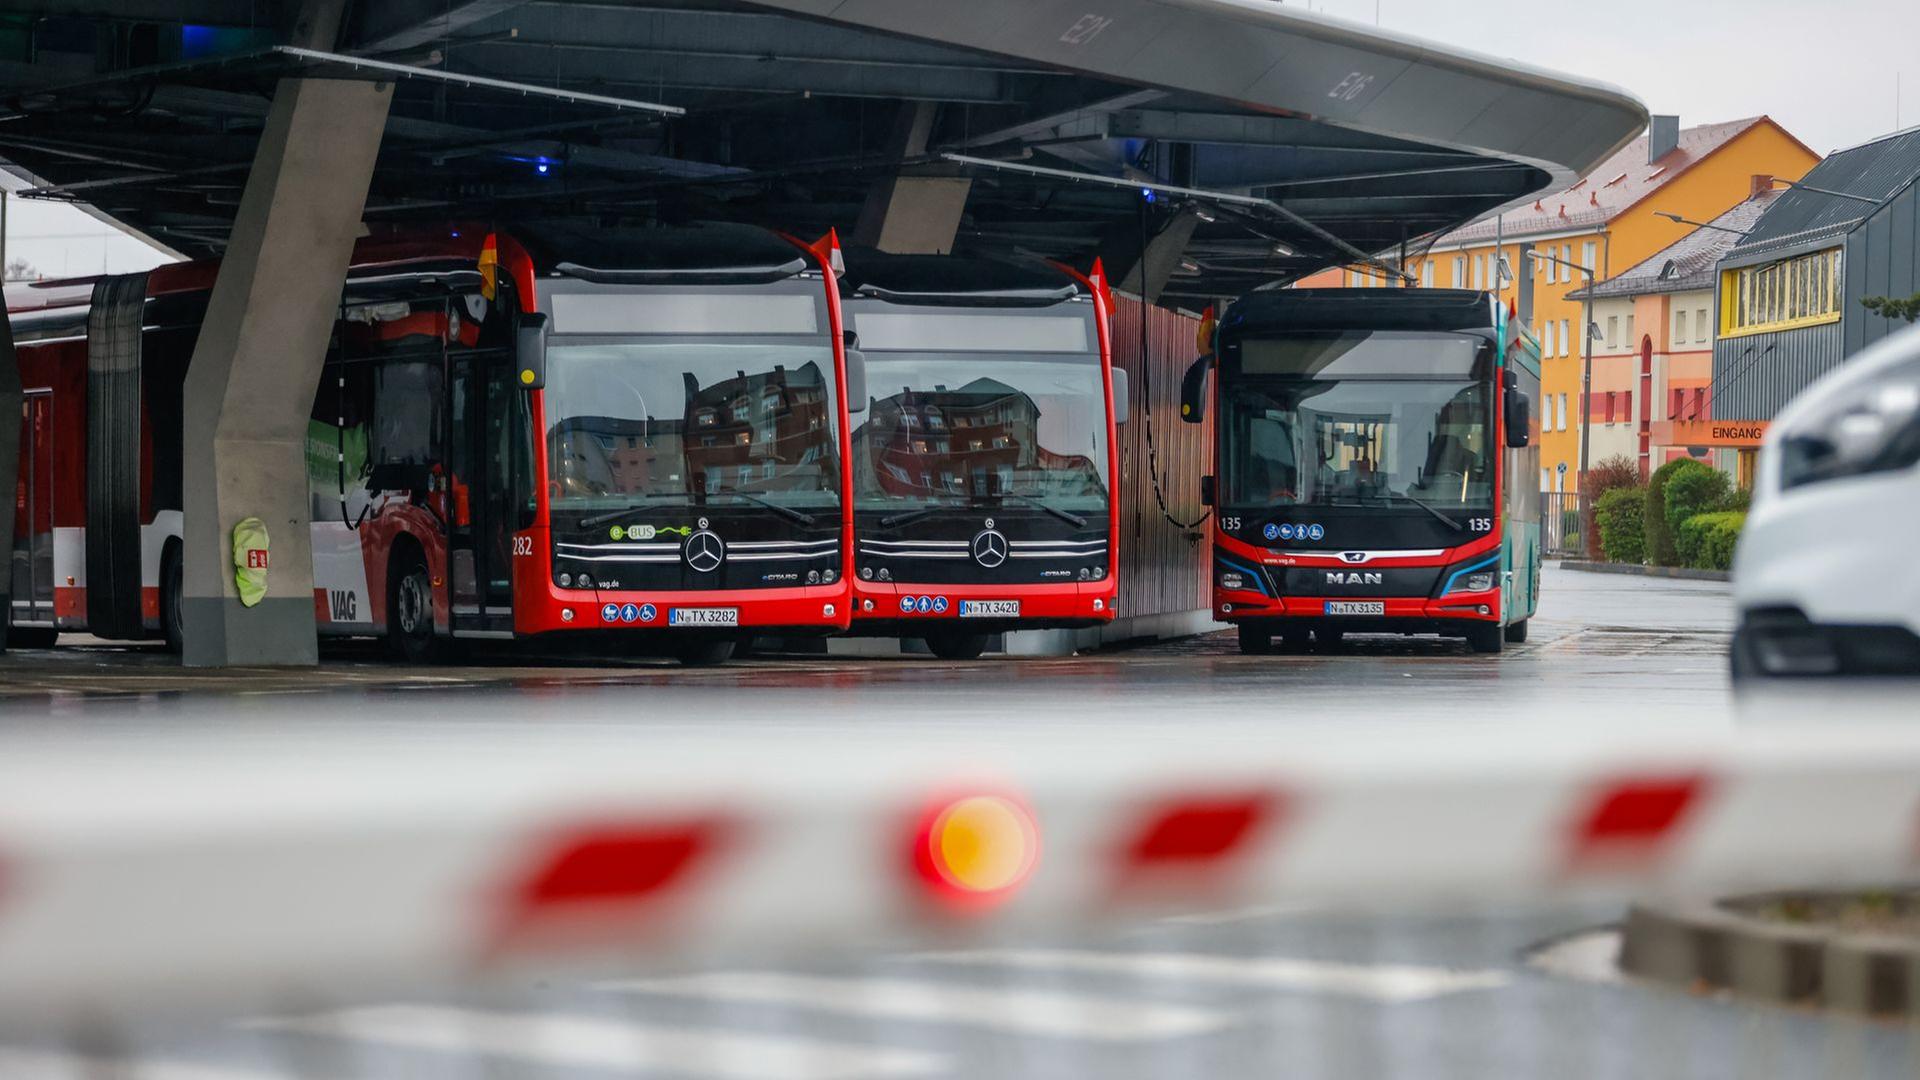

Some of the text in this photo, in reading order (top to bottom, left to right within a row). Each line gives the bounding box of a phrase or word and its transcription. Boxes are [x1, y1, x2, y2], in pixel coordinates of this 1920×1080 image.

[1058, 13, 1114, 44] E21
[1327, 71, 1375, 101] E16
[1712, 427, 1762, 439] EINGANG
[1220, 517, 1242, 532] 135
[1468, 517, 1492, 532] 135
[630, 526, 653, 538] BUS
[512, 536, 533, 556] 282
[598, 580, 620, 589] vag.de
[1326, 572, 1382, 585] MAN
[332, 591, 357, 621] VAG
[965, 603, 1018, 613] N TX 3420
[1331, 603, 1382, 613] N TX 3135
[677, 611, 736, 622] N TX 3282
